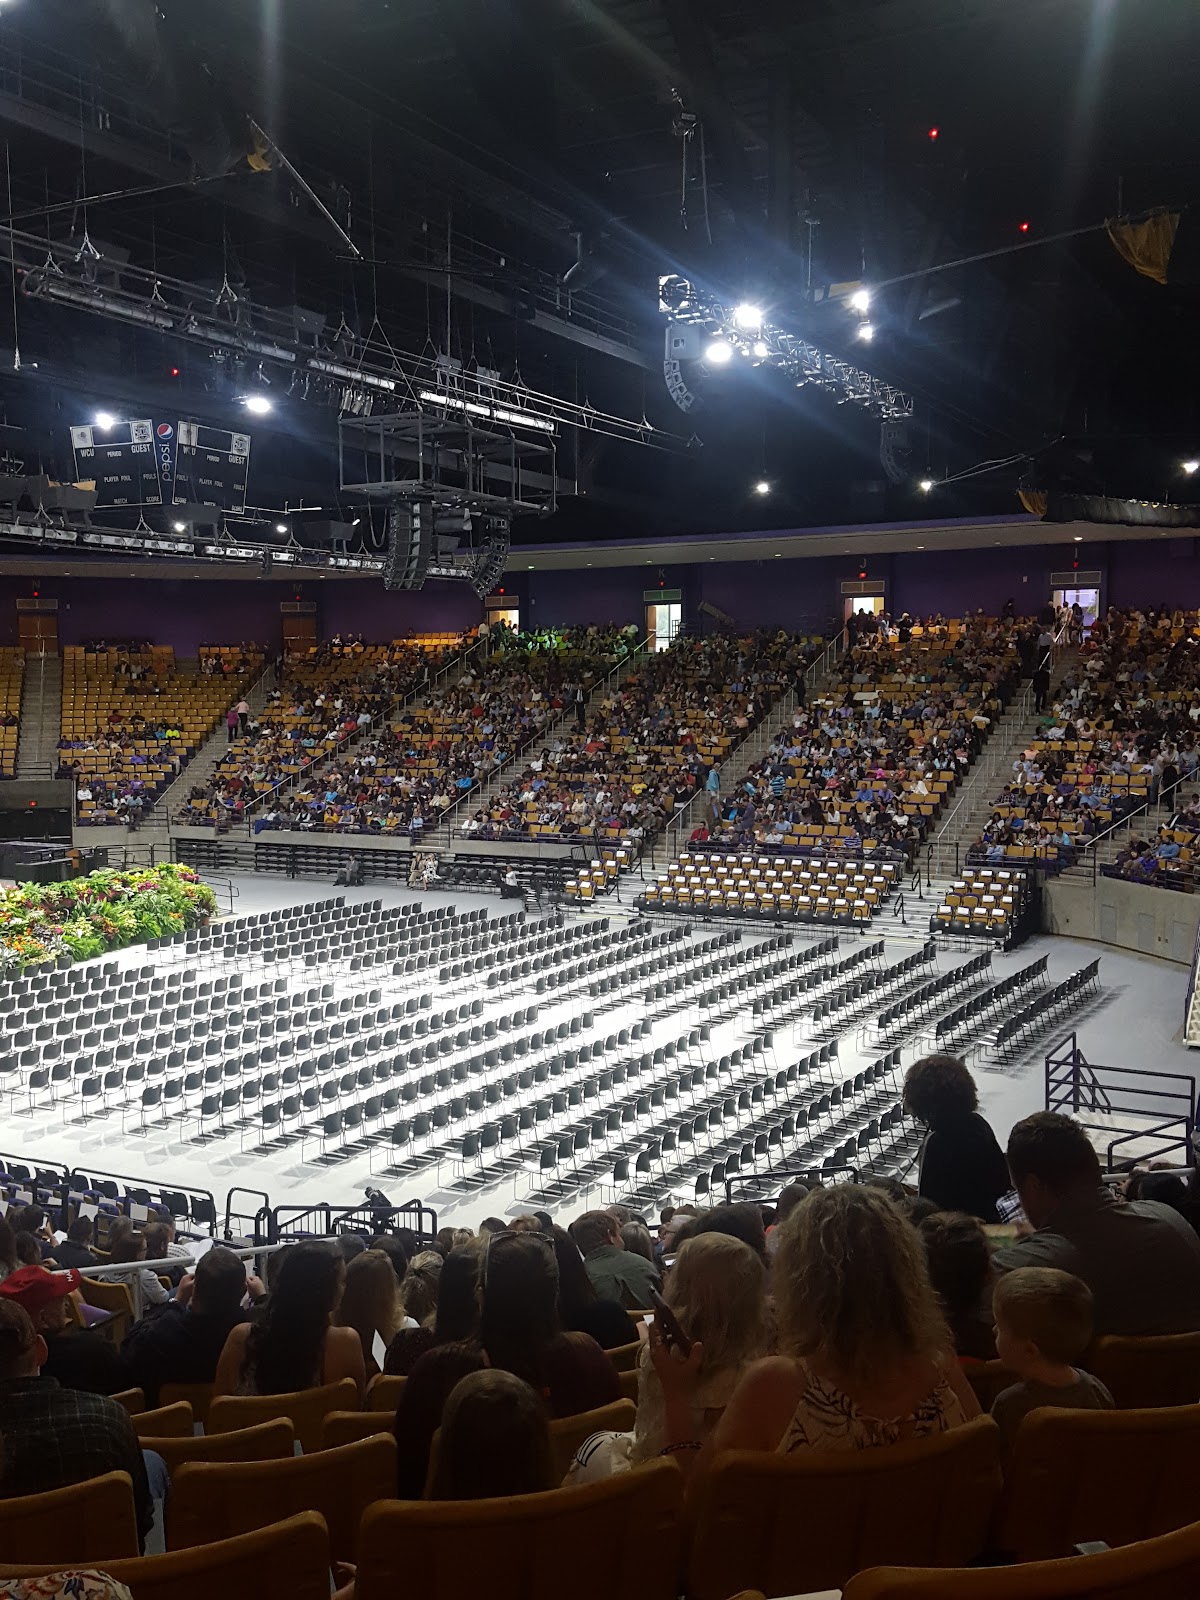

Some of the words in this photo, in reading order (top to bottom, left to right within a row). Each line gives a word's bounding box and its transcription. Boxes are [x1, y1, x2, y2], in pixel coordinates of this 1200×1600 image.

[80, 449, 95, 458] WCU
[131, 444, 151, 453] GUEST
[183, 446, 196, 456] WU
[159, 442, 173, 482] pepsi
[206, 454, 220, 463] PERIOD
[228, 455, 246, 465] GUEST
[199, 477, 213, 486] PLAYER
[214, 480, 224, 488] FOUL
[175, 496, 187, 504] SCORE
[859, 558, 867, 569] J
[658, 568, 666, 578] K
